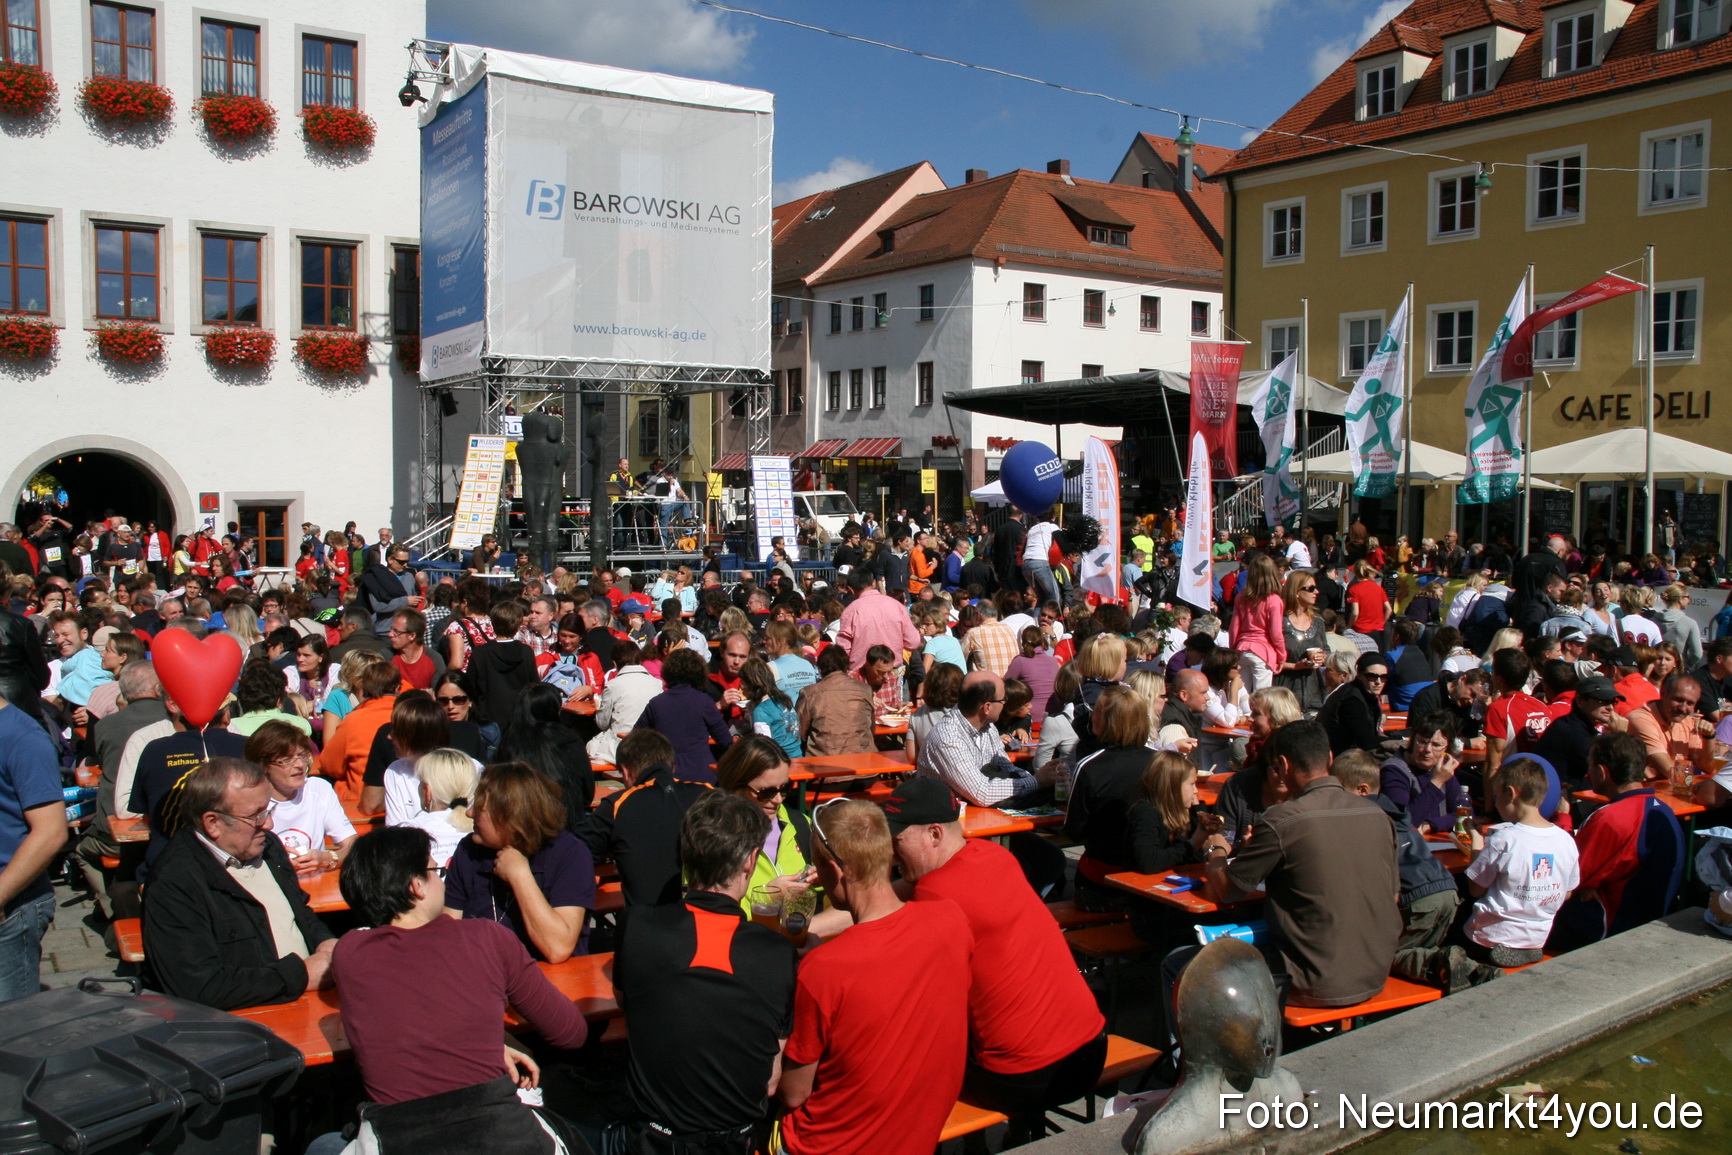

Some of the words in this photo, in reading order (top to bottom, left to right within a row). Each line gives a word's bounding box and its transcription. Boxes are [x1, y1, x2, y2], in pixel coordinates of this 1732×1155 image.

[432, 108, 473, 147] Messeauftritte
[573, 191, 700, 222] BAROWSKI
[708, 204, 741, 225] AG
[574, 213, 647, 227] Veranstaltungs-
[650, 221, 667, 229] und
[670, 222, 740, 236] Mediensysteme
[573, 323, 707, 342] www.barowski-ag.de
[1213, 354, 1239, 365] feiern
[1560, 393, 1632, 422] CAFE
[1653, 390, 1711, 420] DELI
[167, 759, 200, 767] Rathaus
[1516, 884, 1551, 892] neumarkt
